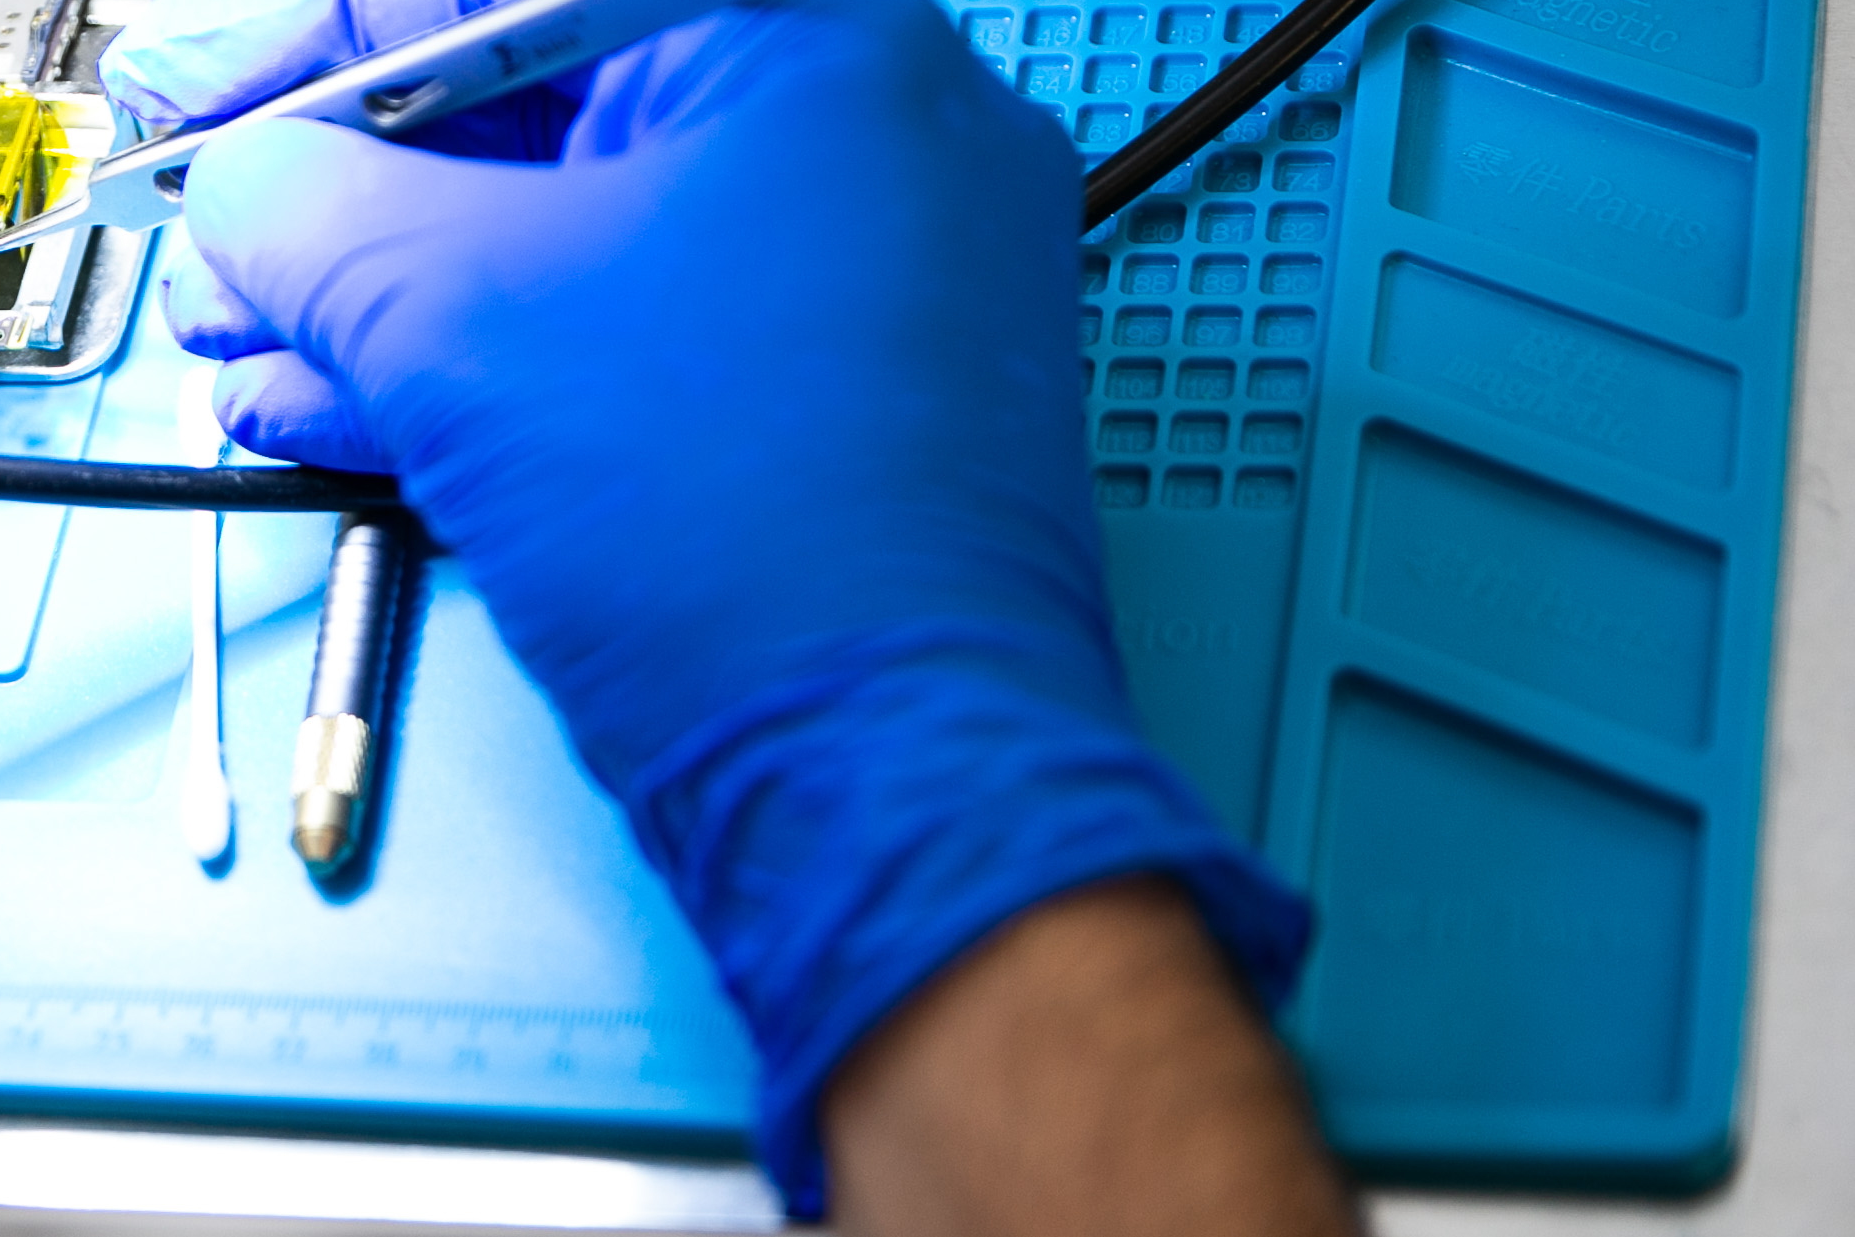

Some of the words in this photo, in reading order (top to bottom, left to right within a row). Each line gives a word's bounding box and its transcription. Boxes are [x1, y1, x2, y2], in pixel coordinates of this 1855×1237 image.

[1037, 26, 1072, 46] 46
[1103, 26, 1140, 46] 47
[1169, 25, 1205, 45] 48
[1096, 75, 1129, 94] 55
[1163, 73, 1197, 94] 56
[1298, 72, 1334, 92] 58
[1088, 123, 1121, 144] 63
[1292, 122, 1329, 141] 66
[1219, 172, 1252, 192] 73
[1288, 172, 1322, 192] 74
[1565, 174, 1707, 249] Parts
[1141, 223, 1177, 243] 80
[1210, 223, 1245, 243] 81
[1279, 222, 1315, 242] 82
[1132, 273, 1171, 294] 88
[1202, 274, 1239, 294] 89
[1272, 274, 1310, 294] 90
[1125, 325, 1164, 345] 96
[1195, 325, 1232, 346] 97
